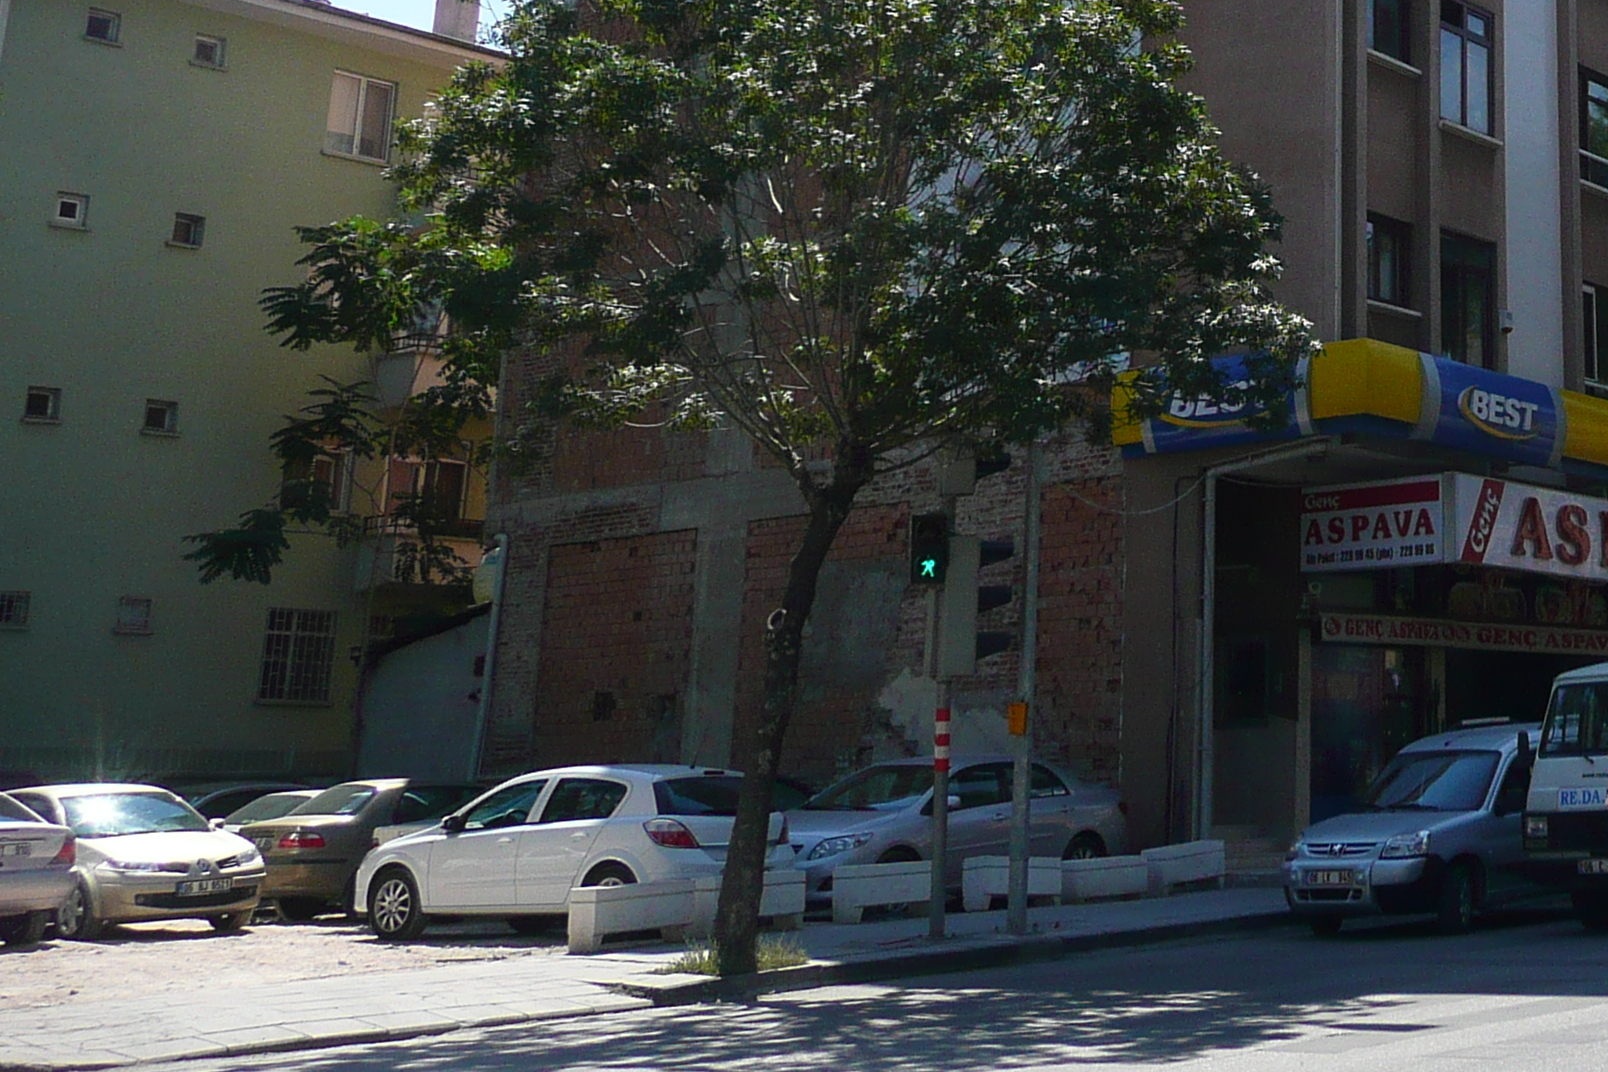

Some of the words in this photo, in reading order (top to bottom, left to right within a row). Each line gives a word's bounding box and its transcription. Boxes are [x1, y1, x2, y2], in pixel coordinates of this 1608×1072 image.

[1473, 389, 1538, 430] BEST
[1305, 494, 1341, 510] Genç
[1305, 508, 1435, 546] ASPAVA
[1471, 488, 1500, 553] Genç
[1345, 618, 1383, 640] GENÇ
[1476, 628, 1537, 650] GENÇ
[1561, 789, 1608, 806] RE.DA.
